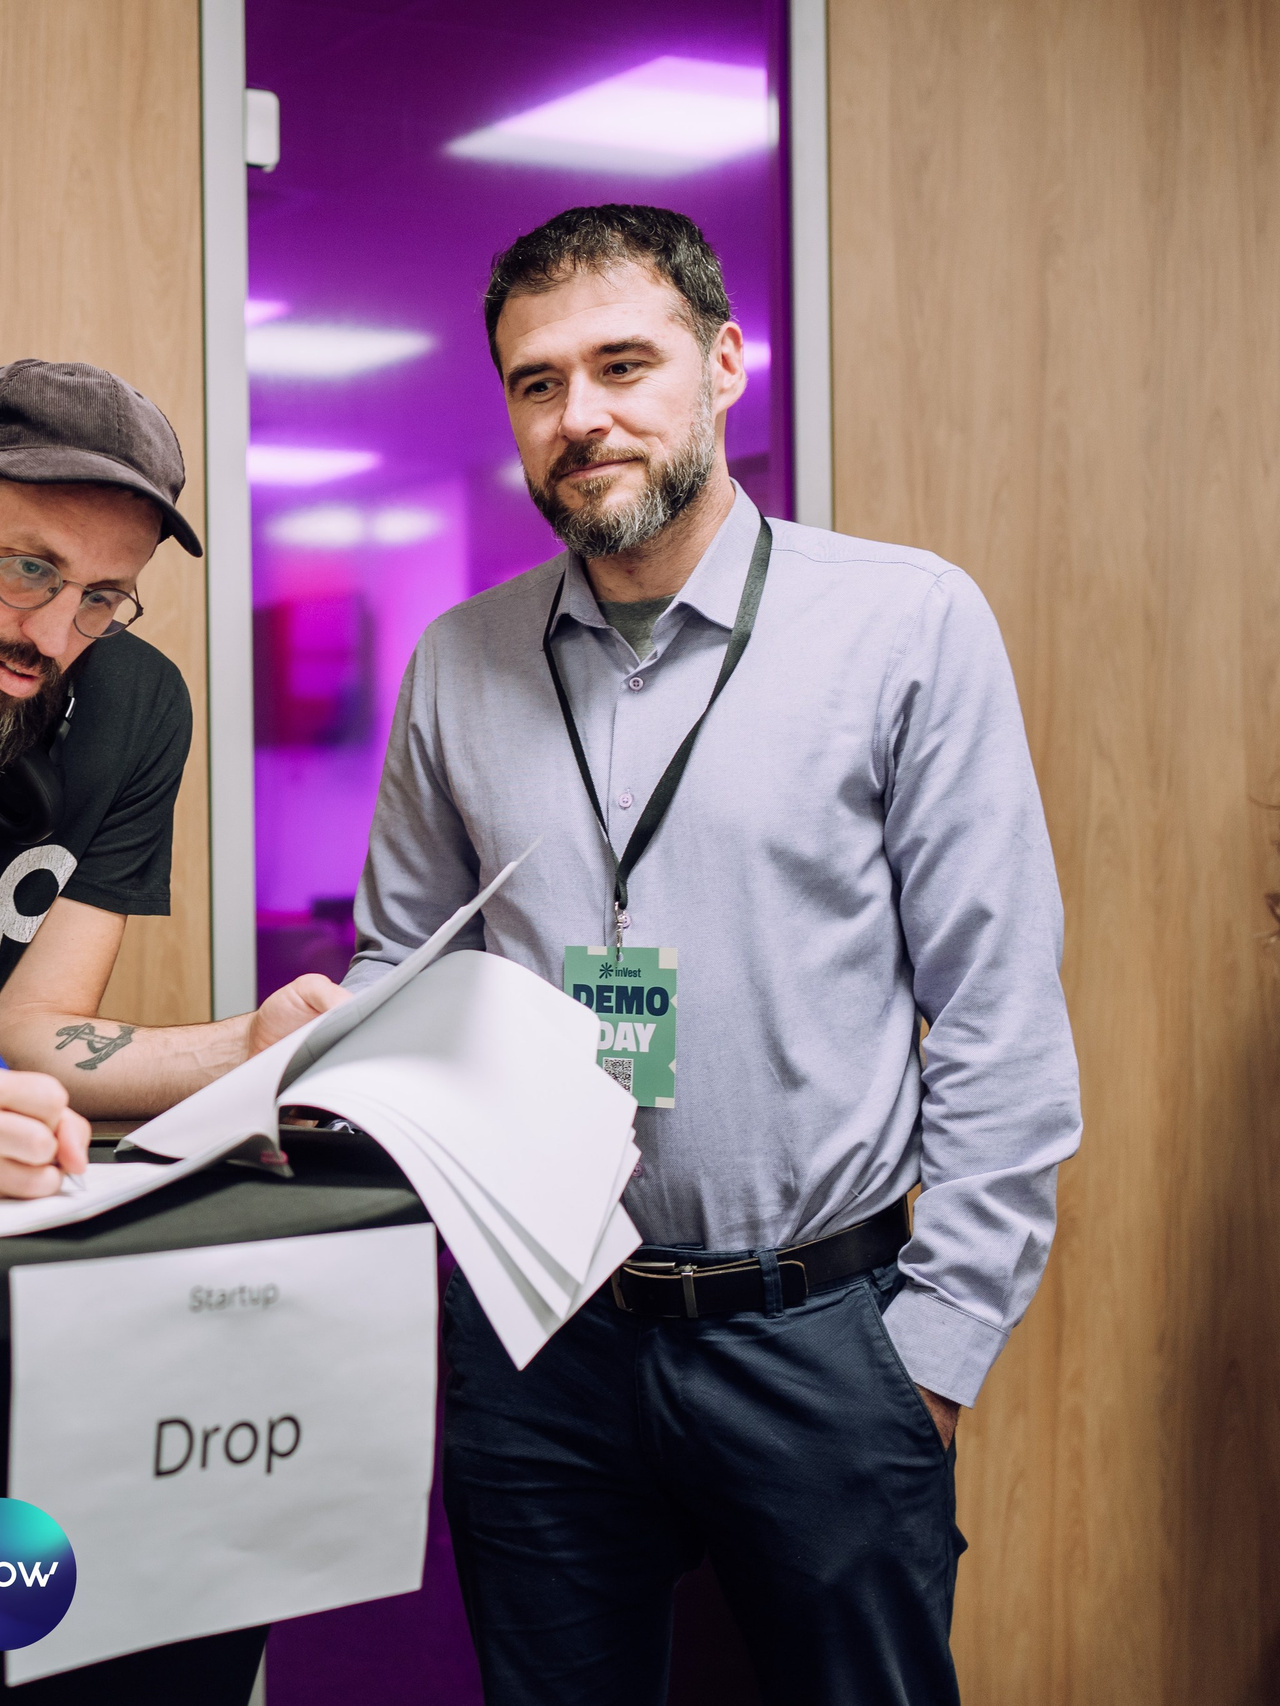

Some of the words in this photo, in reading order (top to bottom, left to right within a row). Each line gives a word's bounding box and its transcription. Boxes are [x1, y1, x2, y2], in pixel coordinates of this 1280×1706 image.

[615, 966, 642, 979] inVest
[572, 983, 670, 1017] DEMO
[596, 1020, 657, 1053] DAY
[188, 1282, 280, 1314] Startup
[152, 1411, 302, 1479] Drop
